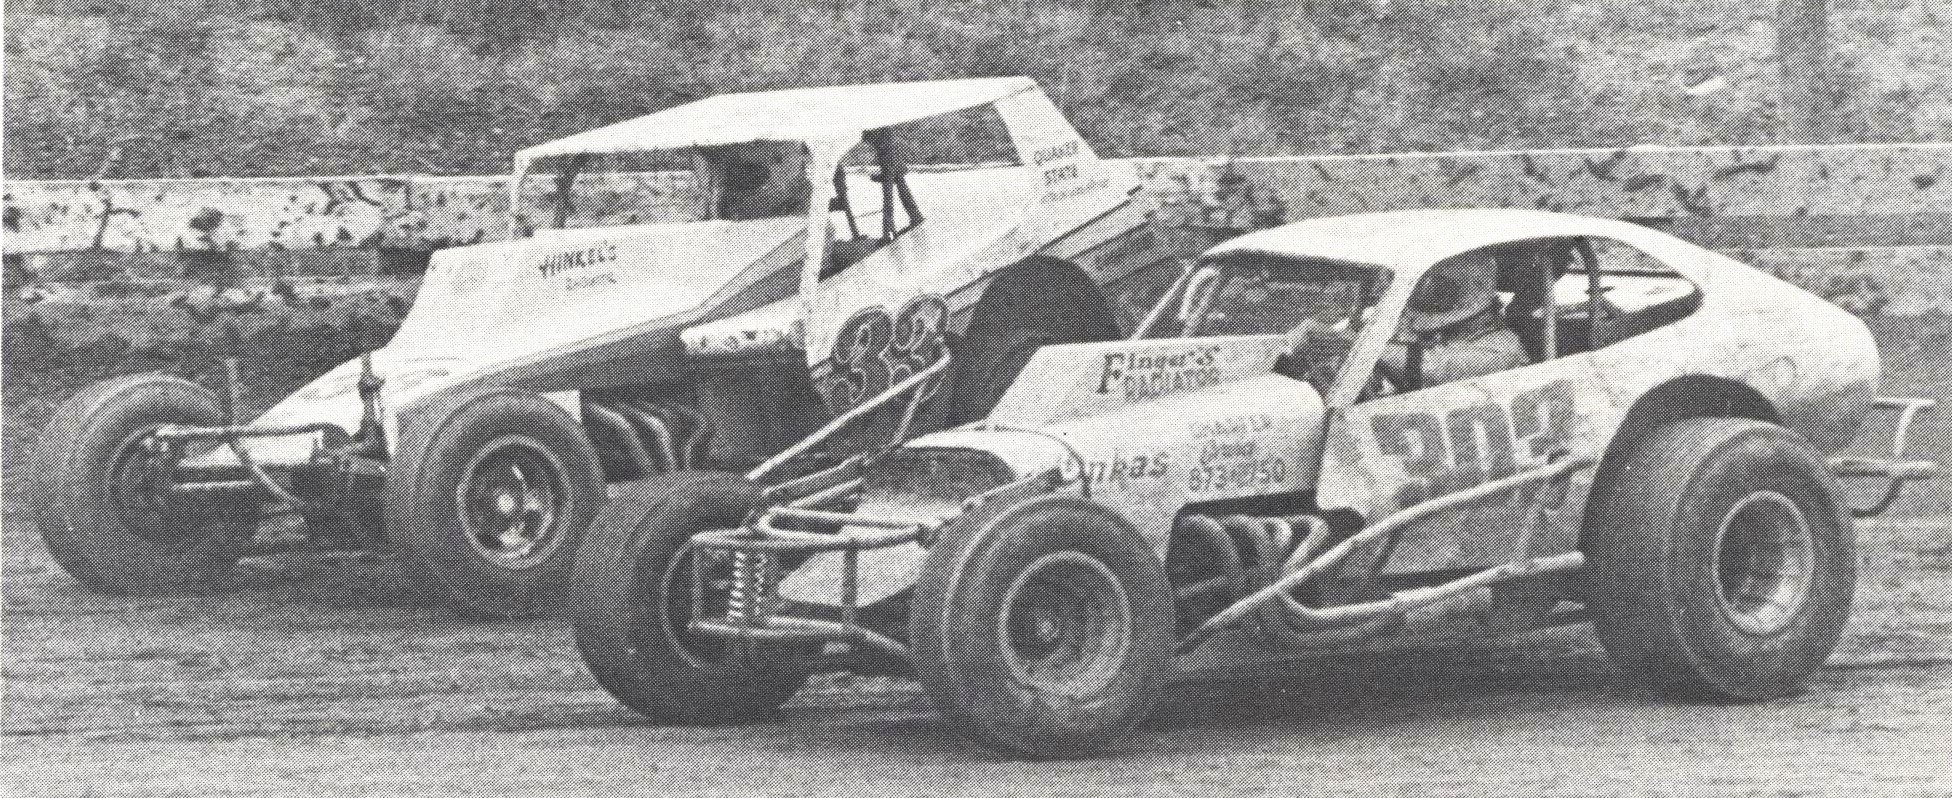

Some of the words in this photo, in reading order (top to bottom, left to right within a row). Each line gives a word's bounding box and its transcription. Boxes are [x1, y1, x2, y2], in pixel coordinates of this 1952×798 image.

[1034, 141, 1078, 166] QUAKER
[1044, 164, 1077, 186] STATE
[1124, 368, 1221, 403] RADIATOR
